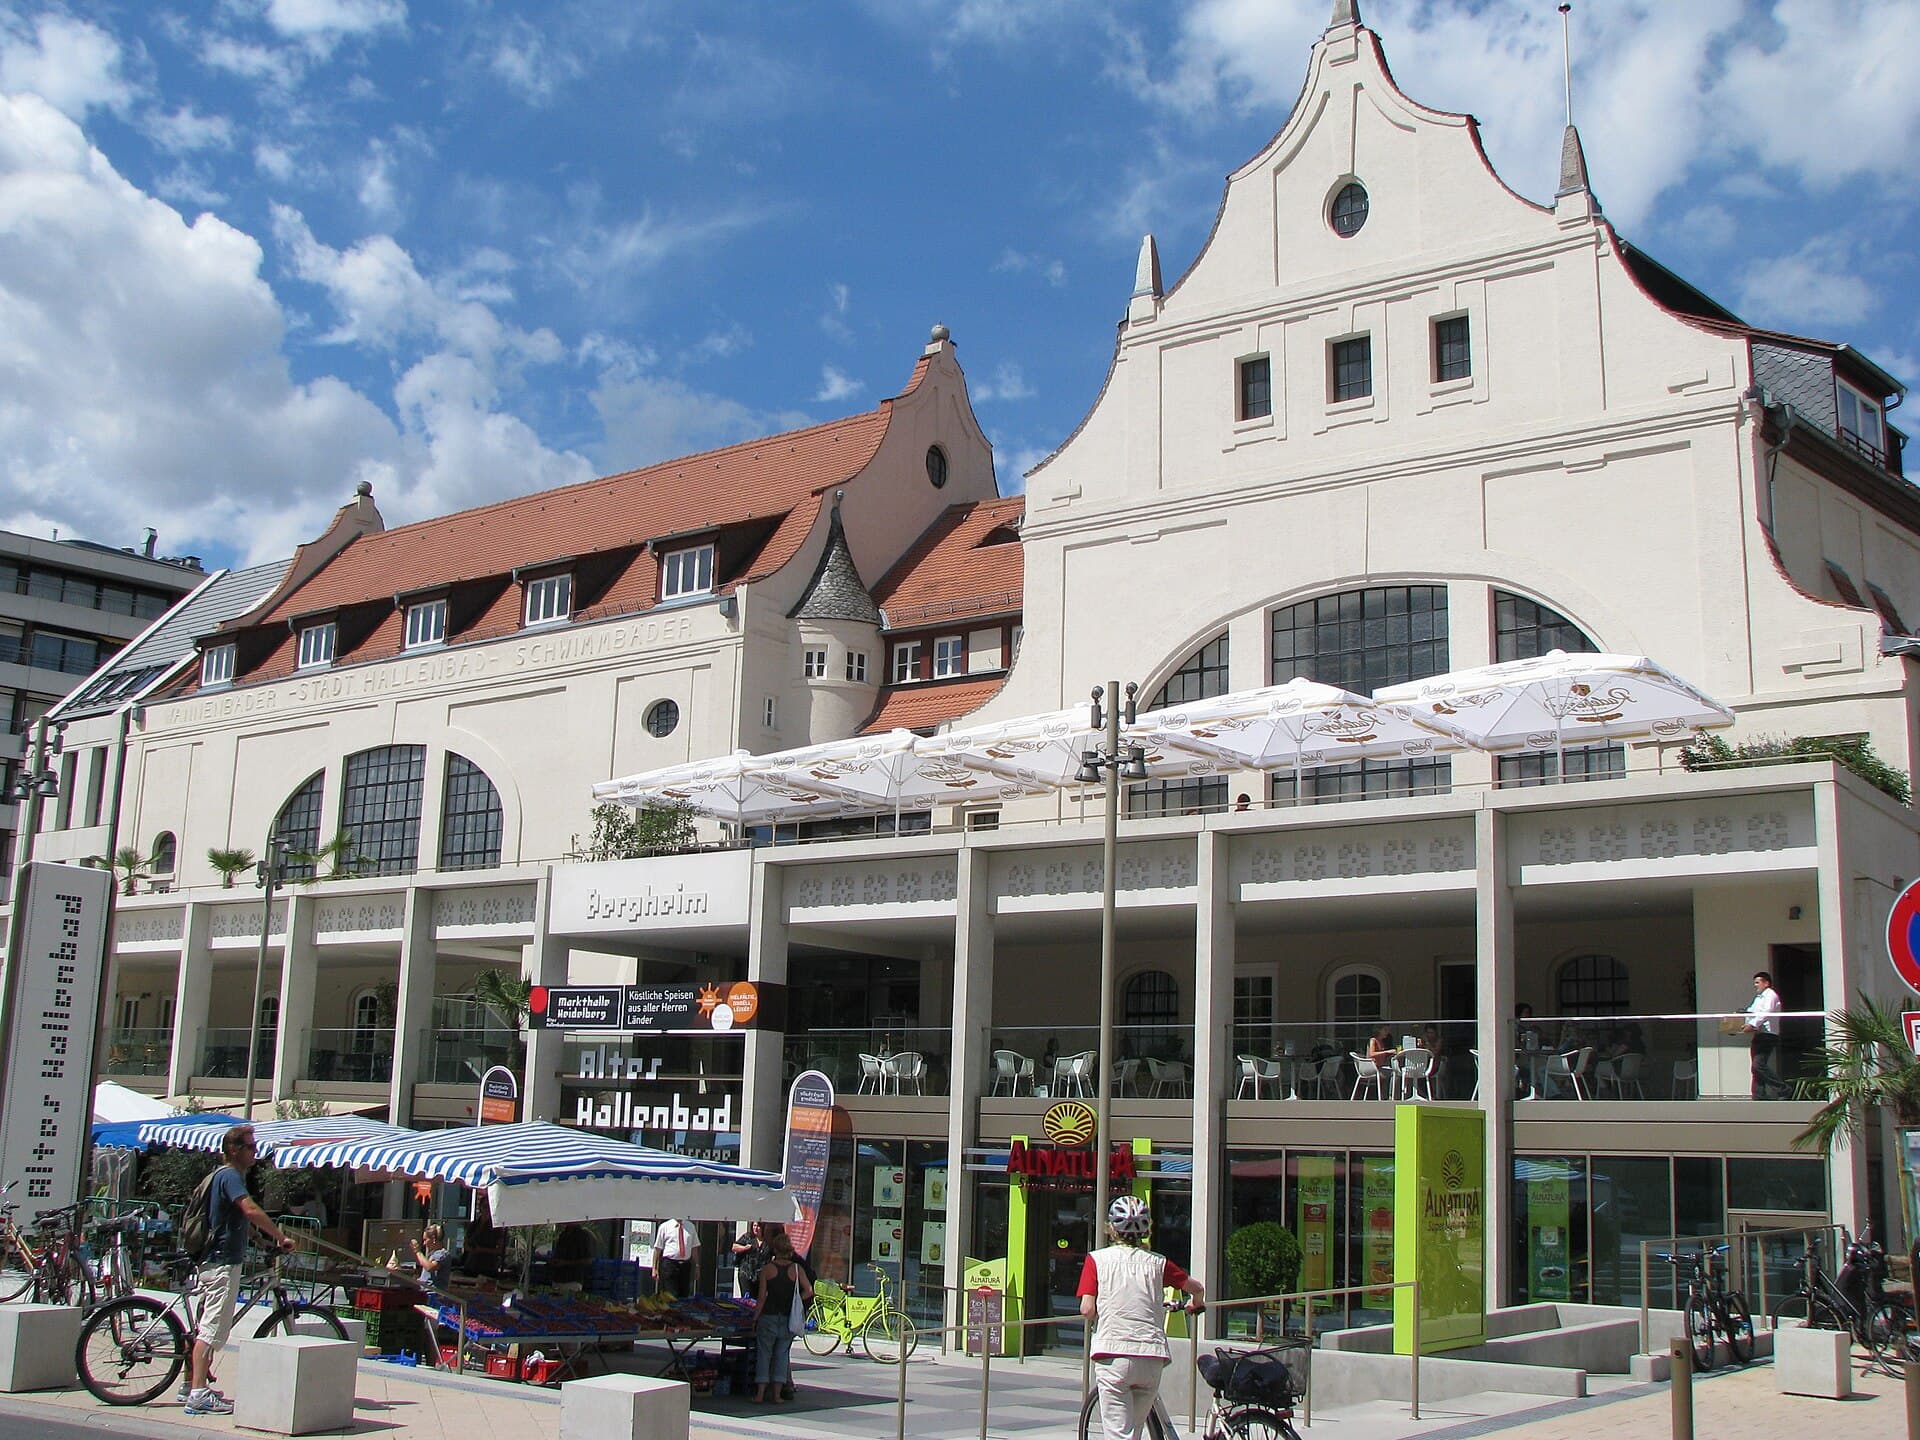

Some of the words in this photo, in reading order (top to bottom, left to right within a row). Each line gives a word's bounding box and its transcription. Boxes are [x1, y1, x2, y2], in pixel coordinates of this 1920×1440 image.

[516, 616, 693, 666] SCHWIMMBÄDER
[586, 883, 709, 922] Bergheim
[41, 894, 83, 1078] Hallenbad
[558, 995, 610, 1007] Markthalle
[629, 990, 663, 1001] Köstliche
[664, 990, 694, 1003] Speisen
[557, 1006, 607, 1020] Heidelberg
[627, 1005, 641, 1013] aus
[643, 1002, 660, 1013] aller
[661, 1003, 688, 1013] Herren
[627, 1015, 654, 1025] Länder
[579, 1044, 662, 1079] Altes
[576, 1092, 731, 1131] Hallenbad
[25, 1094, 60, 1198] Altes
[1424, 1186, 1480, 1217] ALNATURA
[970, 1275, 1001, 1284] ALNATURA
